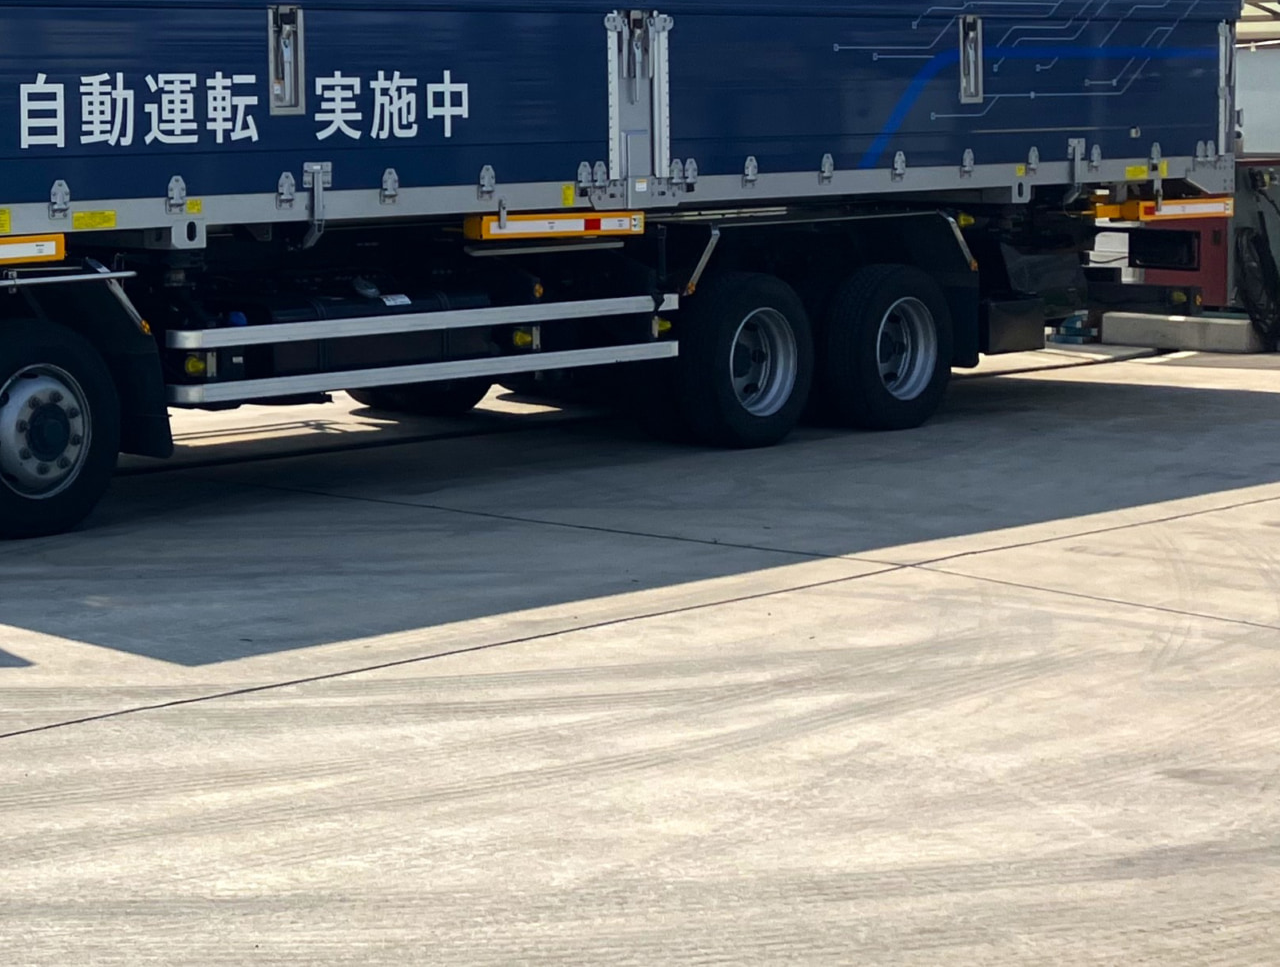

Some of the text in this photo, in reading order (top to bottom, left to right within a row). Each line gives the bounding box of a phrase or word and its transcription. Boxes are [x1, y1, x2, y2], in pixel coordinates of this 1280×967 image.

[19, 70, 470, 149] 自動運転 実施中
